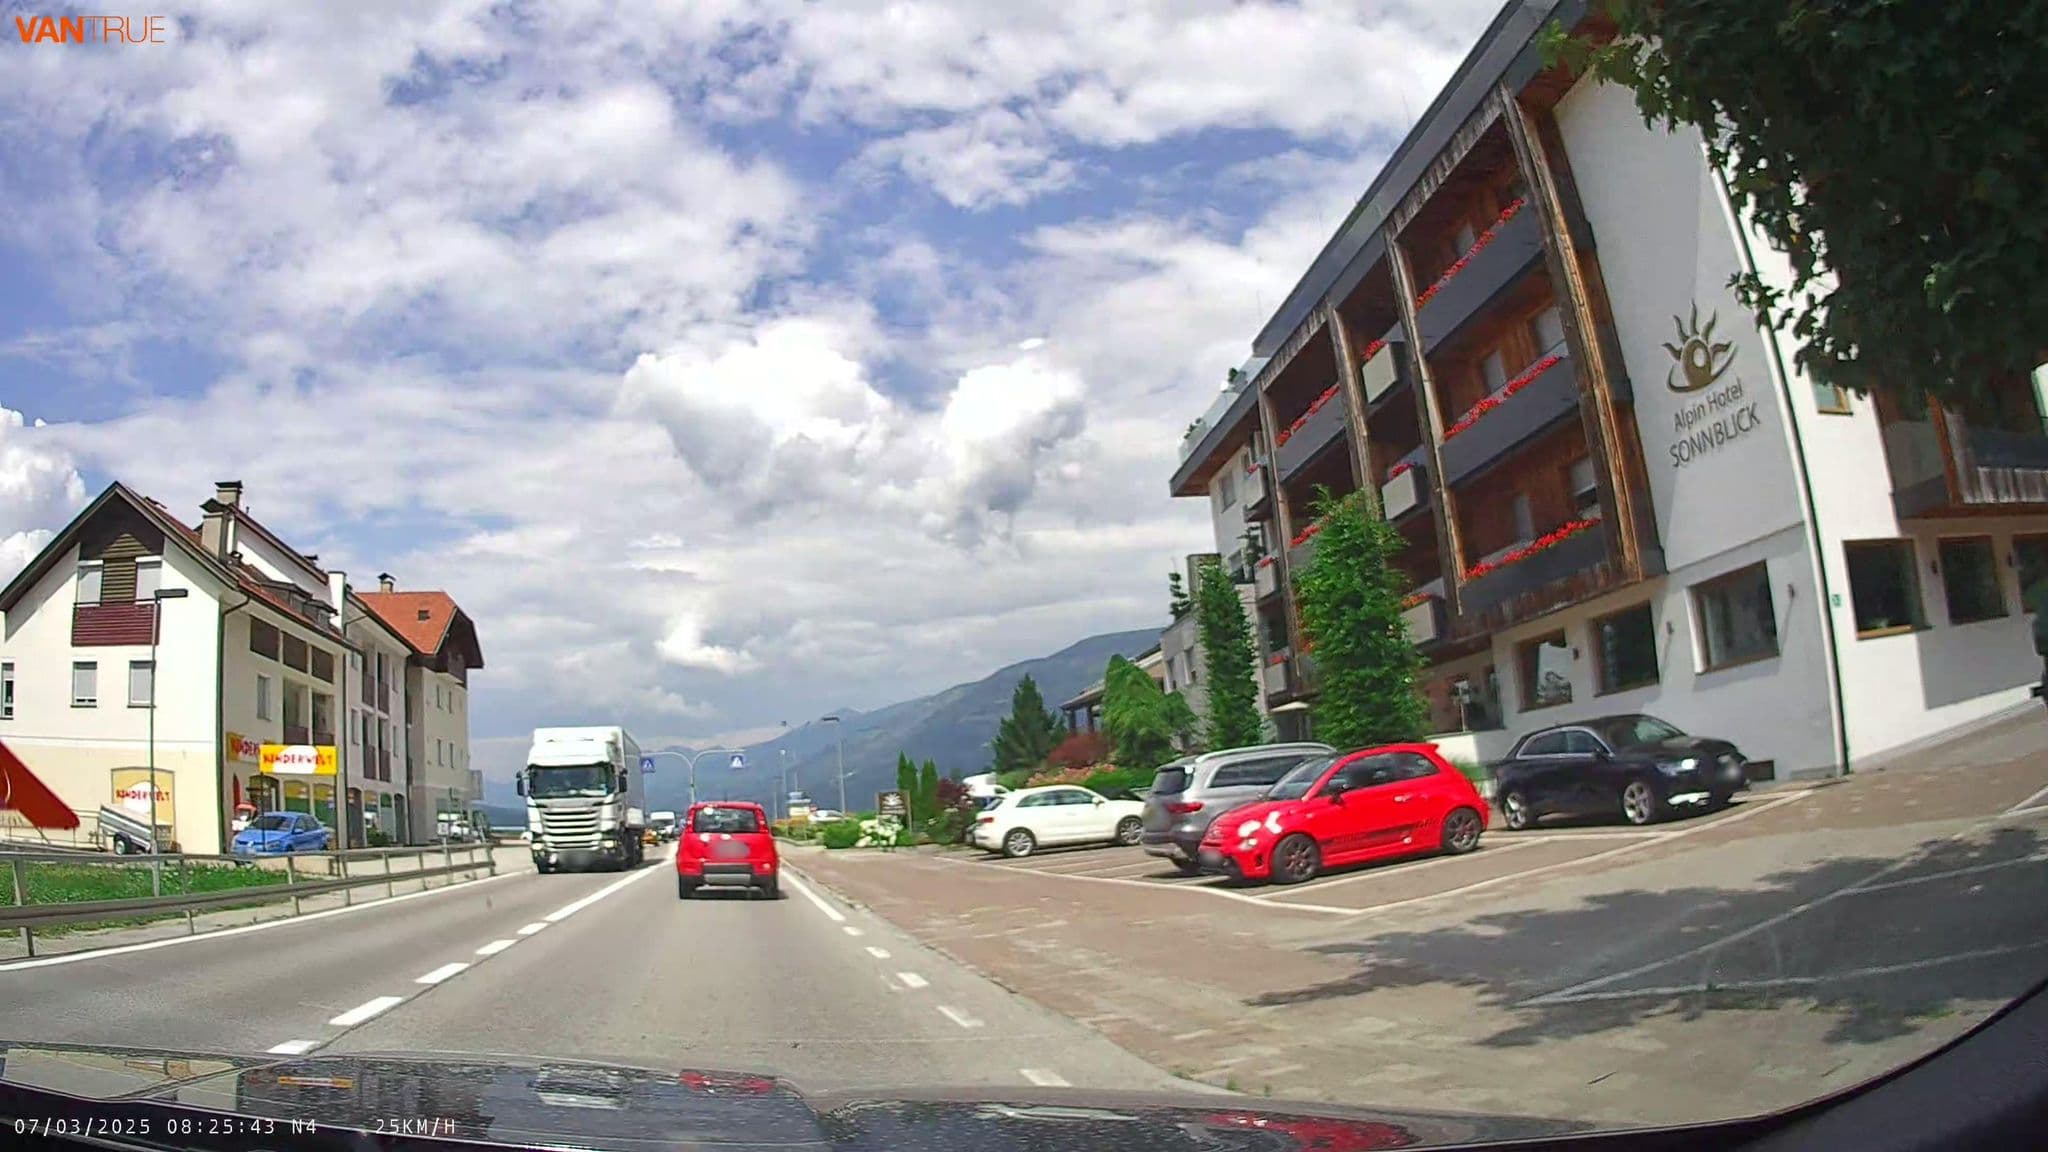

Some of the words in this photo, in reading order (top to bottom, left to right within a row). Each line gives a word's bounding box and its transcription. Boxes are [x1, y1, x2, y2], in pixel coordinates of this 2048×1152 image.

[1674, 403, 1706, 432] Alpin
[1706, 377, 1744, 410] Hotel
[1669, 402, 1761, 468] SONNBLICK
[263, 753, 334, 766] KINDERWELT
